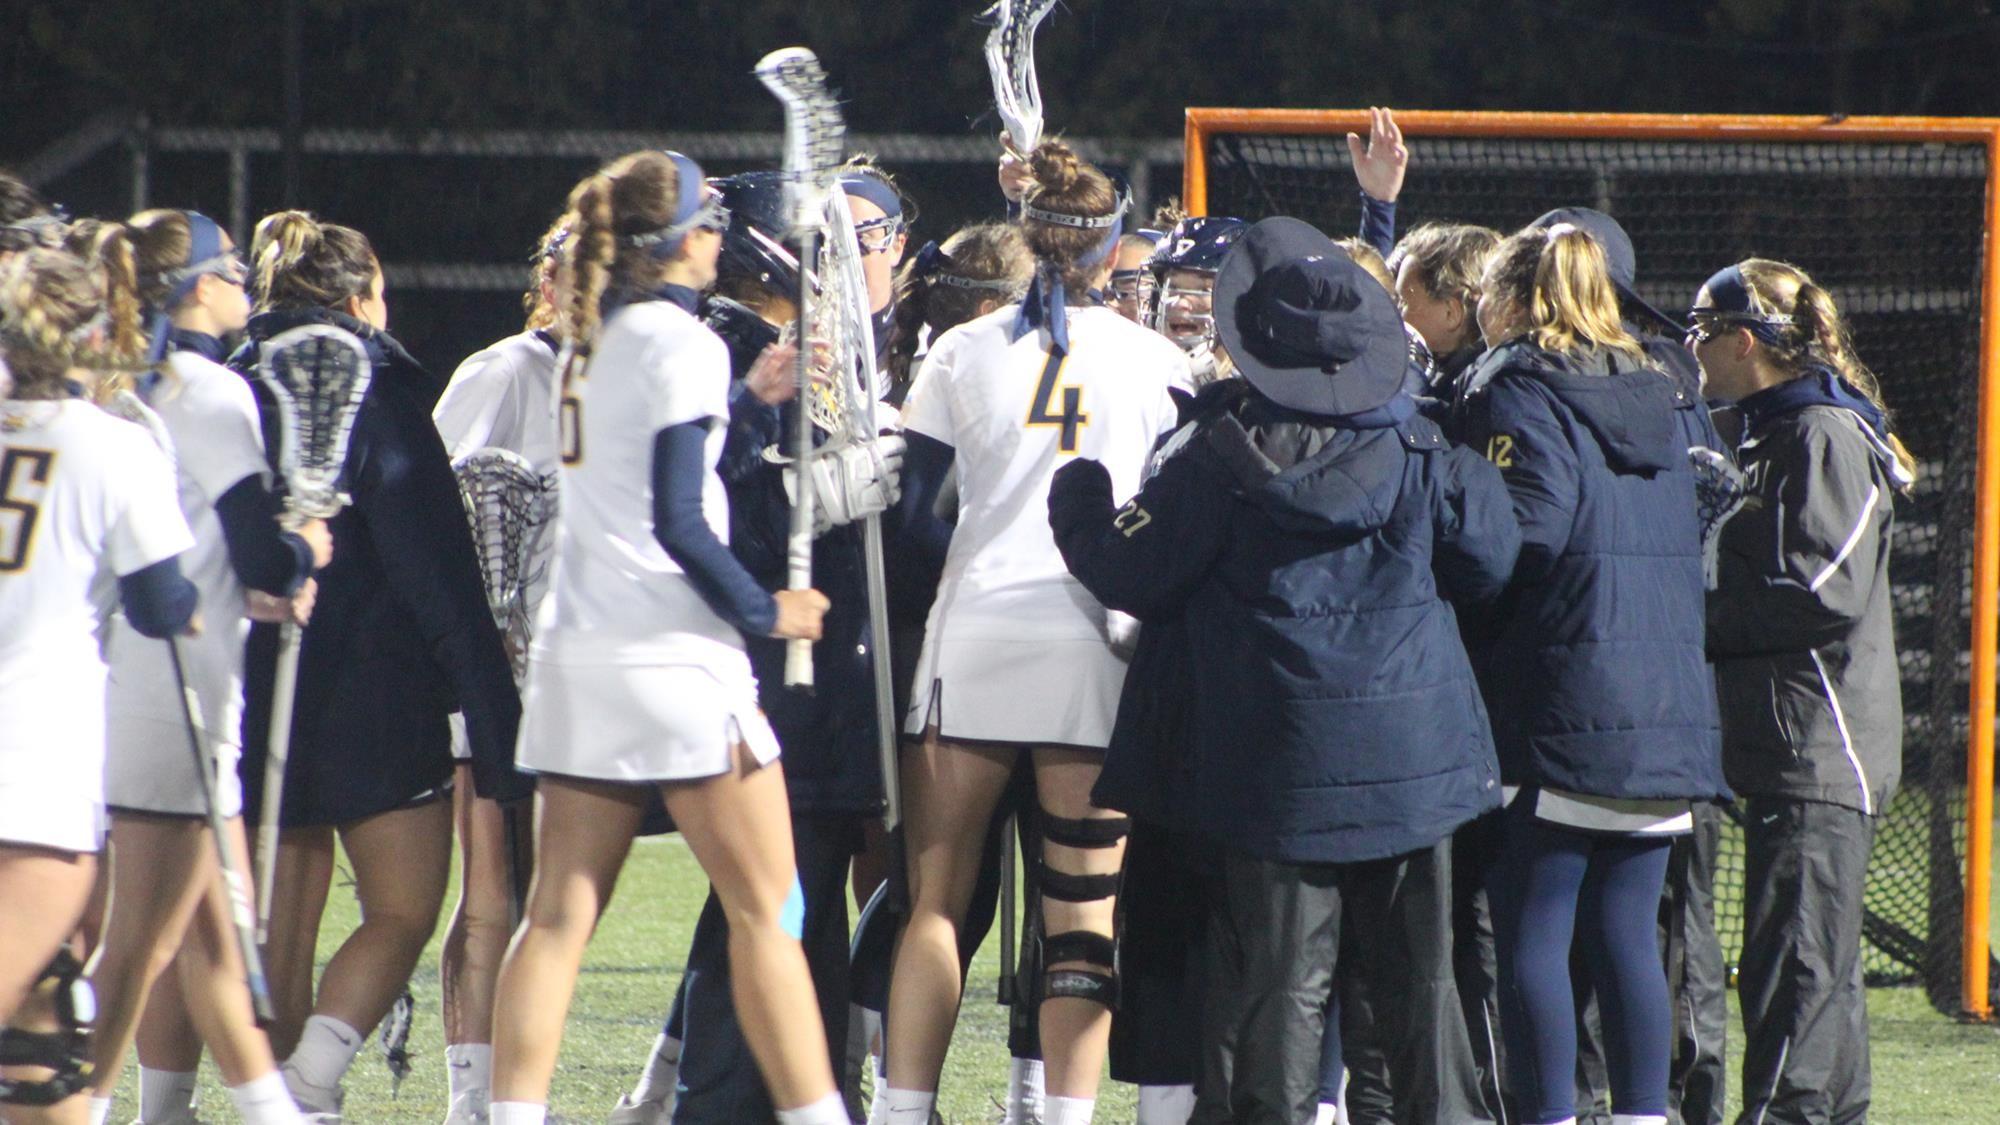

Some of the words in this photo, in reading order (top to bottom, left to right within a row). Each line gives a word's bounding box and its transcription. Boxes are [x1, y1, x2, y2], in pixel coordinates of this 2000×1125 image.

[1024, 341, 1090, 454] 4
[1487, 435, 1512, 467] 12
[1113, 499, 1151, 538] 27
